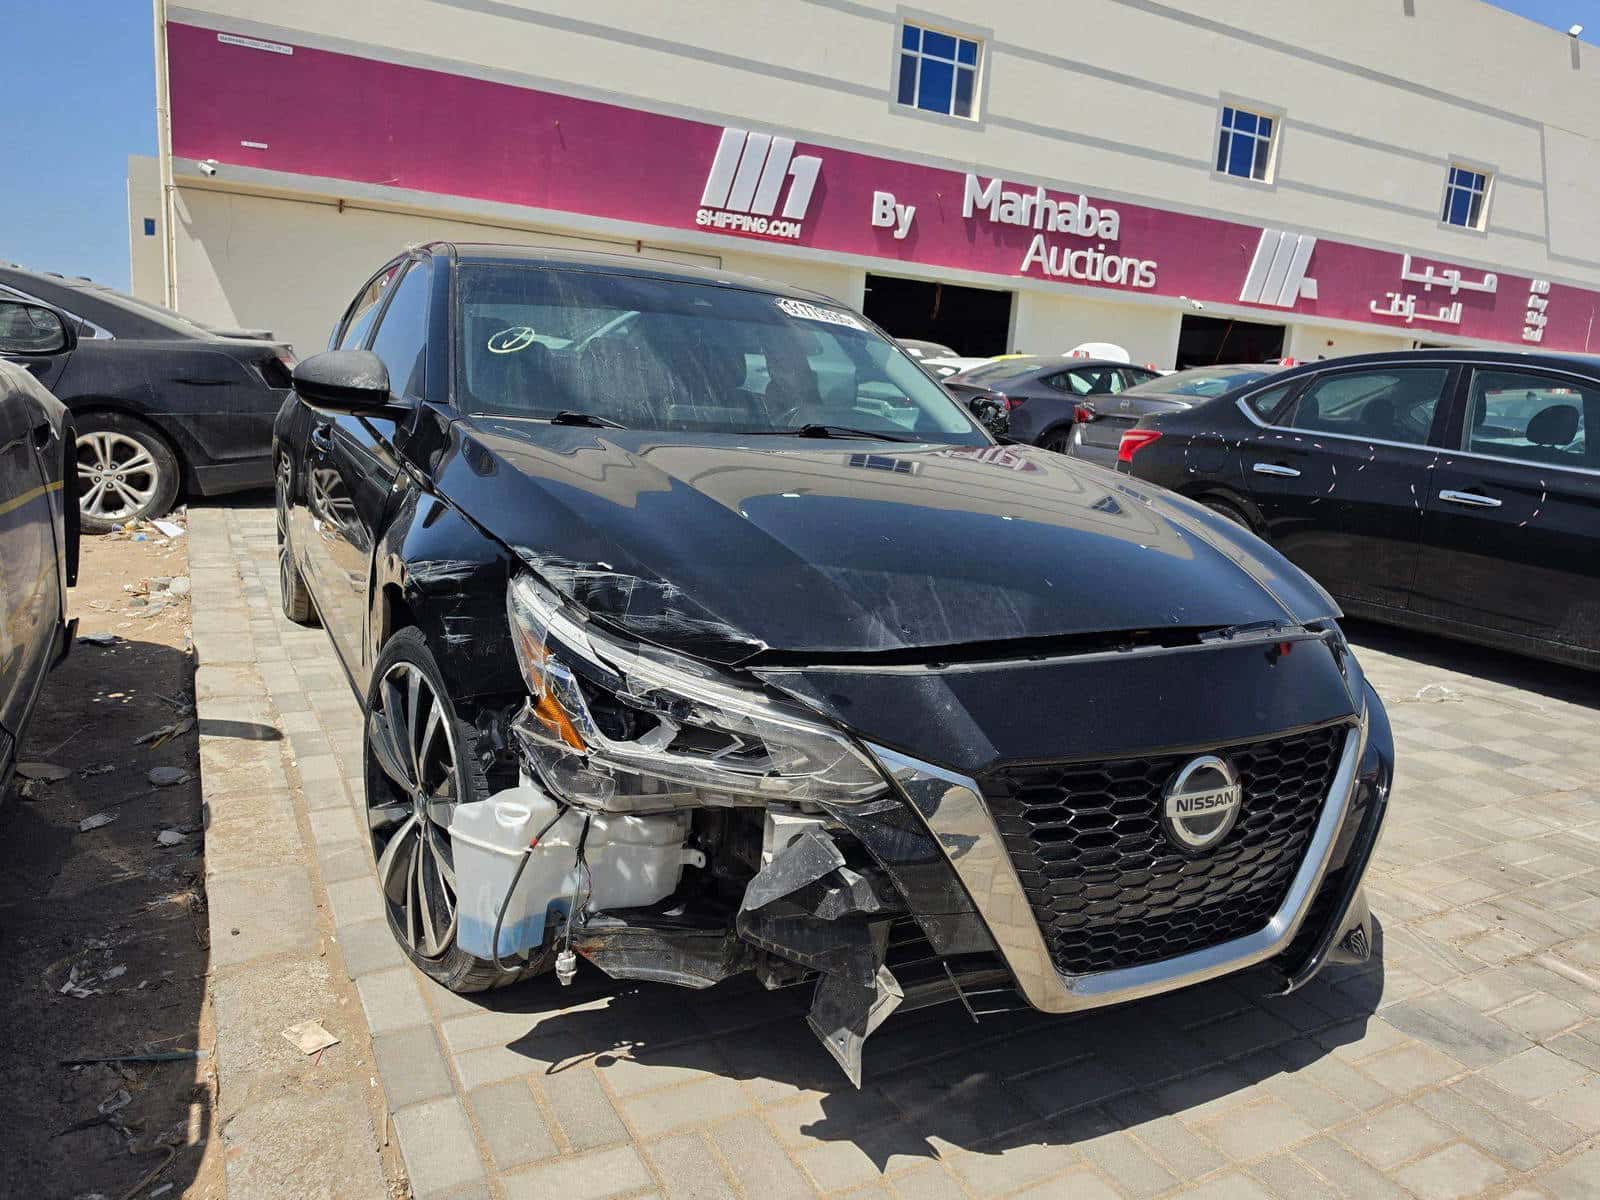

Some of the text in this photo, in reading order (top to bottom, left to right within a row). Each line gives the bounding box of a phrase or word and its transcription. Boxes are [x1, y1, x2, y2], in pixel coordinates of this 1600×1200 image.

[695, 208, 802, 239] SHIPPING.COM
[871, 190, 917, 240] By
[961, 173, 1121, 242] Marhaba
[1020, 234, 1158, 289] Auctions
[1175, 790, 1234, 813] NISSAN
